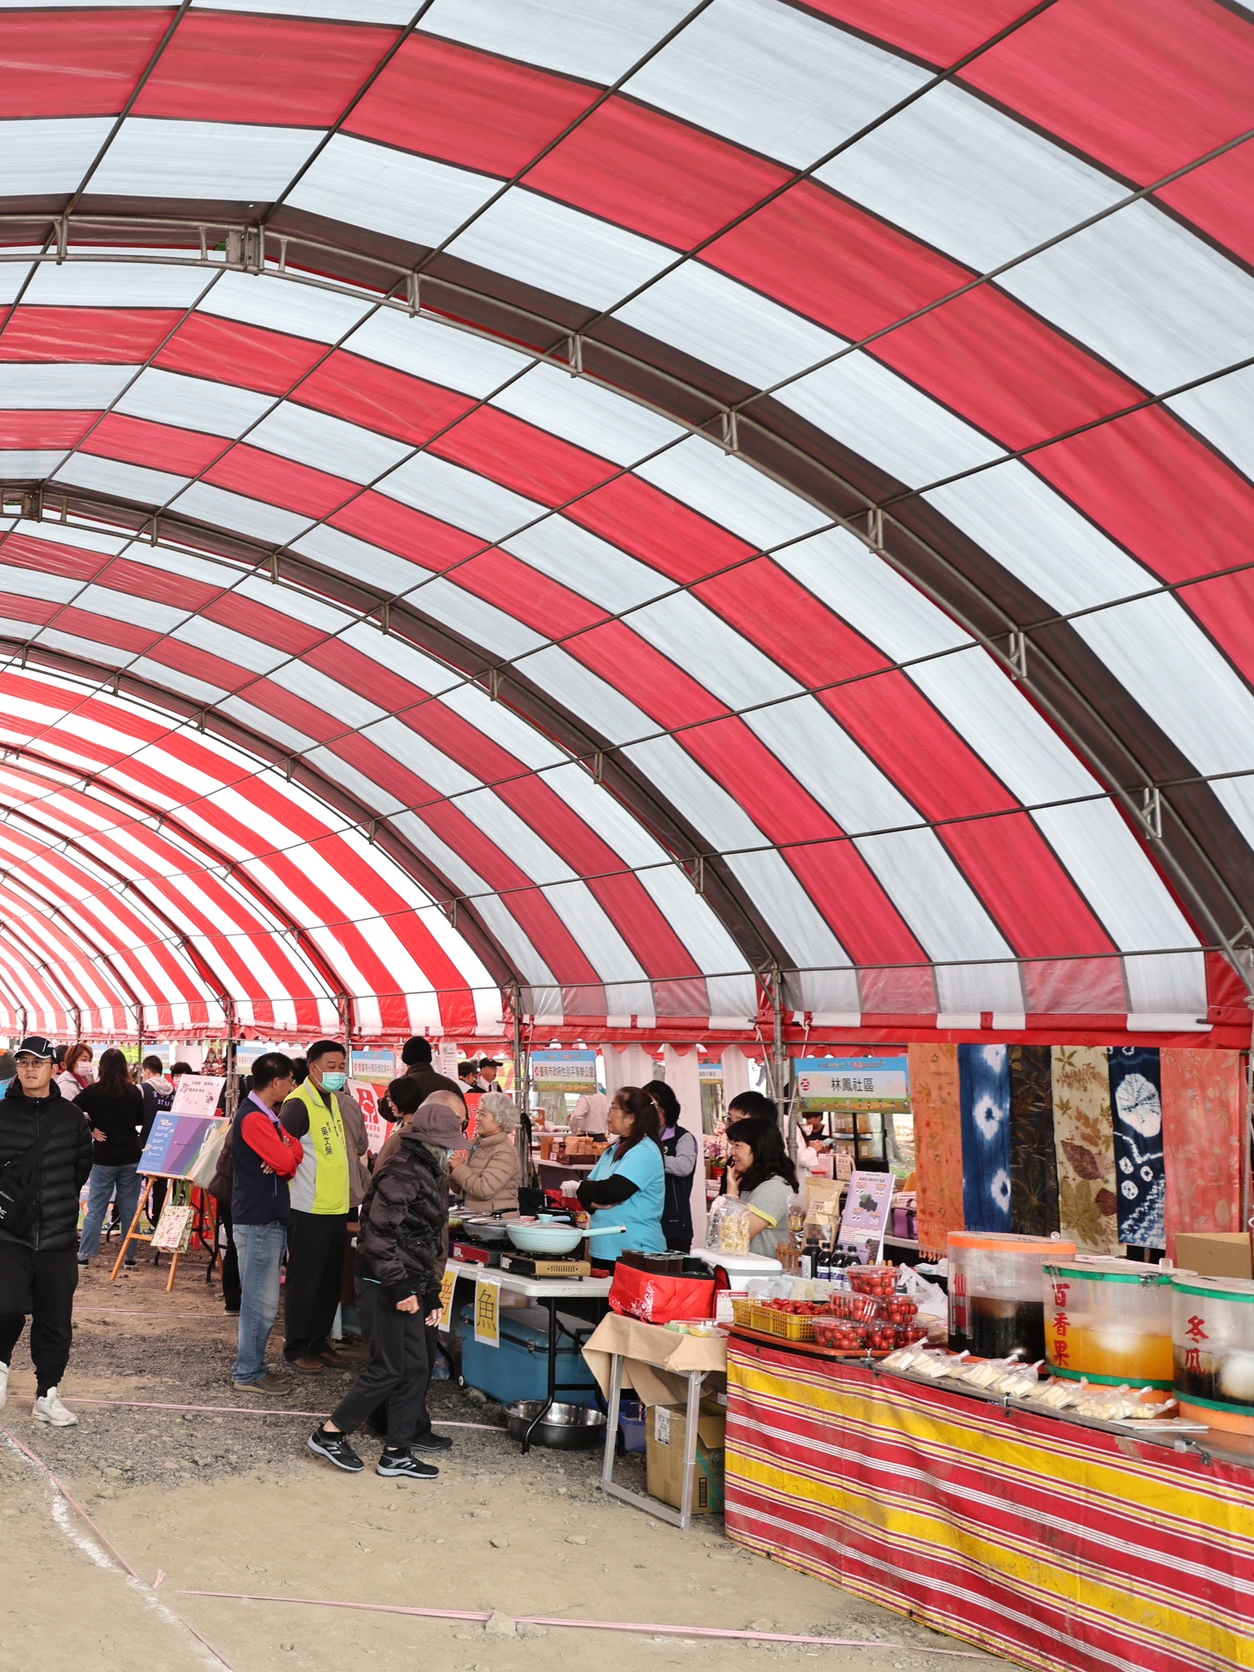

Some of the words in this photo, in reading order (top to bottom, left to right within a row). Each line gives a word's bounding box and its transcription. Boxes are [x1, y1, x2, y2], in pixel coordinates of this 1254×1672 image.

[831, 1078, 874, 1092] 林鳳社區
[477, 1289, 496, 1332] 魚
[1052, 1283, 1071, 1367] 百香果
[1184, 1315, 1209, 1375] 冬瓜
